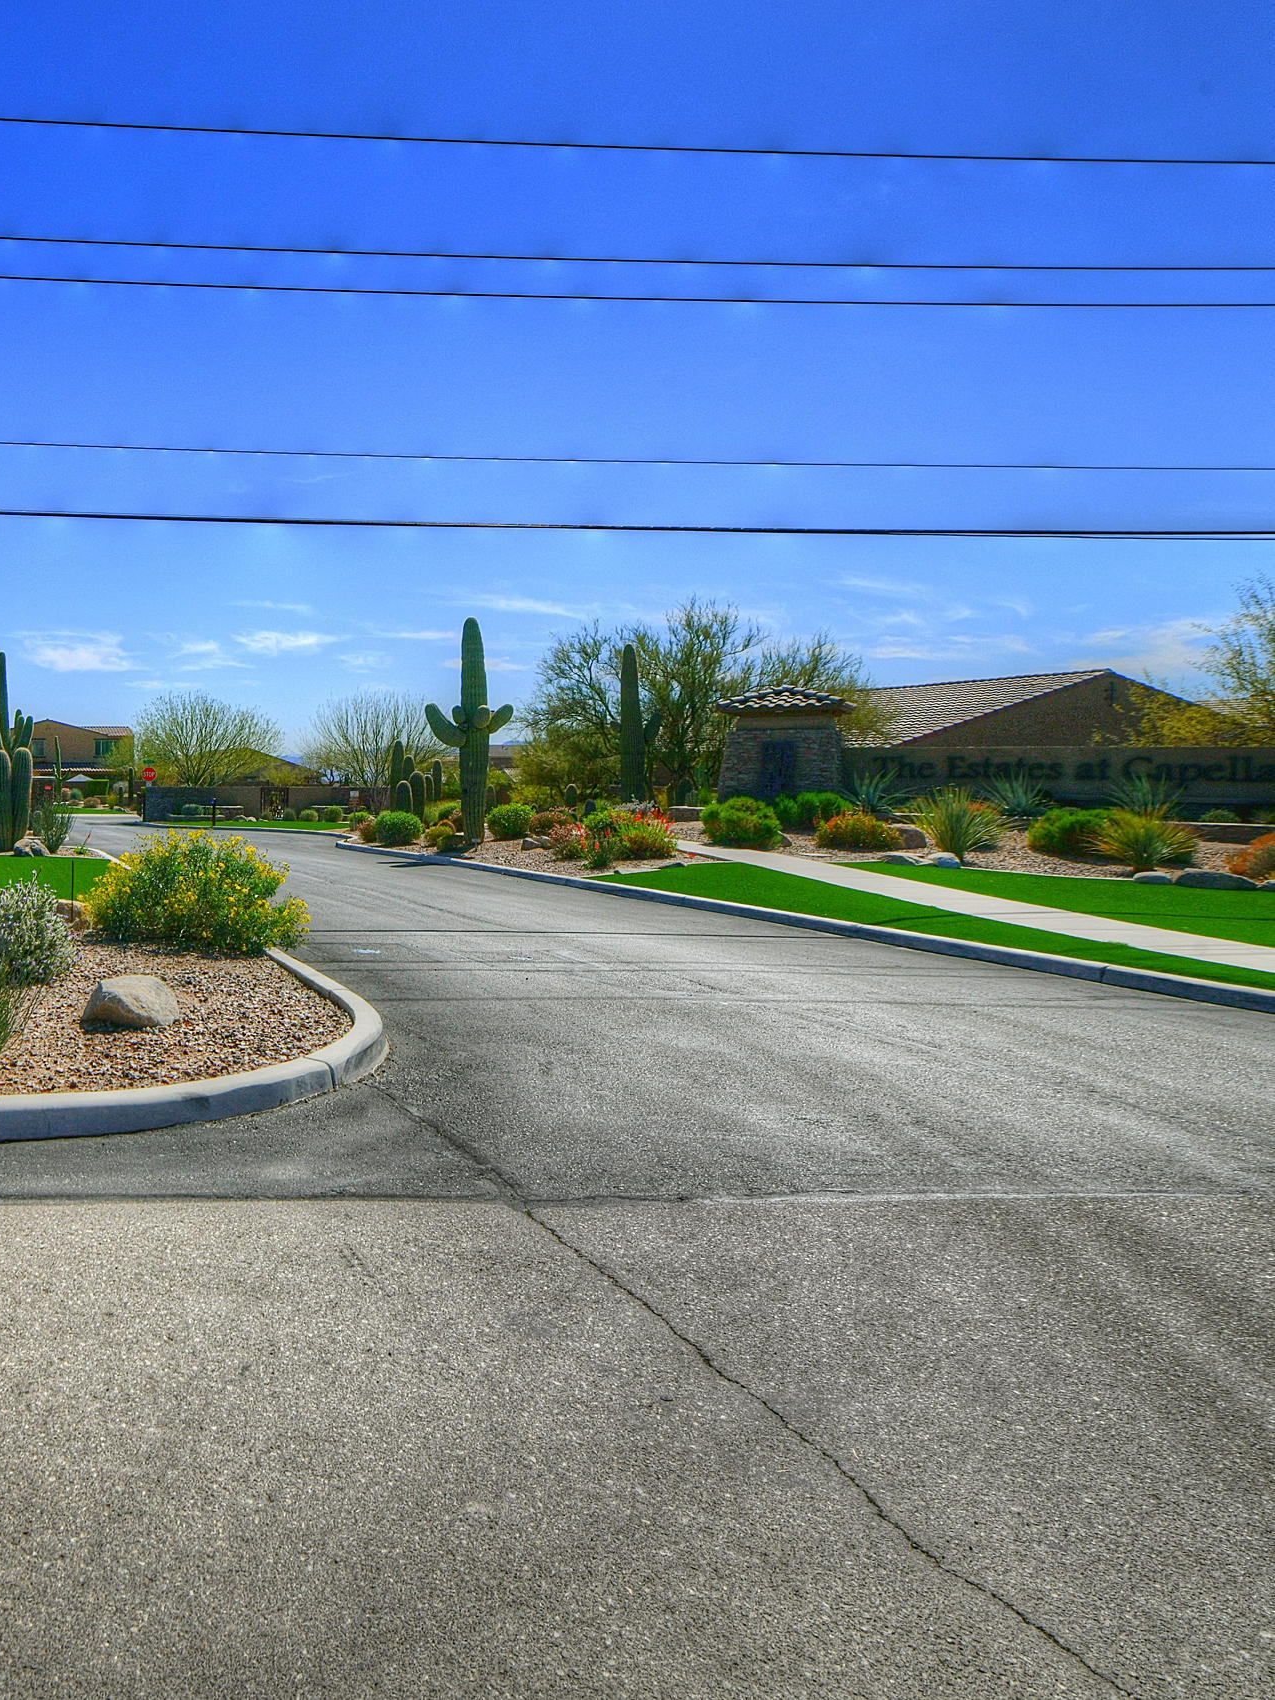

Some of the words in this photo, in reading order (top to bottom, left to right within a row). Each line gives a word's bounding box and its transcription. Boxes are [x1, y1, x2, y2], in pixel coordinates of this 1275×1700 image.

[871, 755, 936, 779] The
[946, 755, 1064, 780] Estates
[1074, 757, 1111, 781] at
[1122, 756, 1275, 790] Capella
